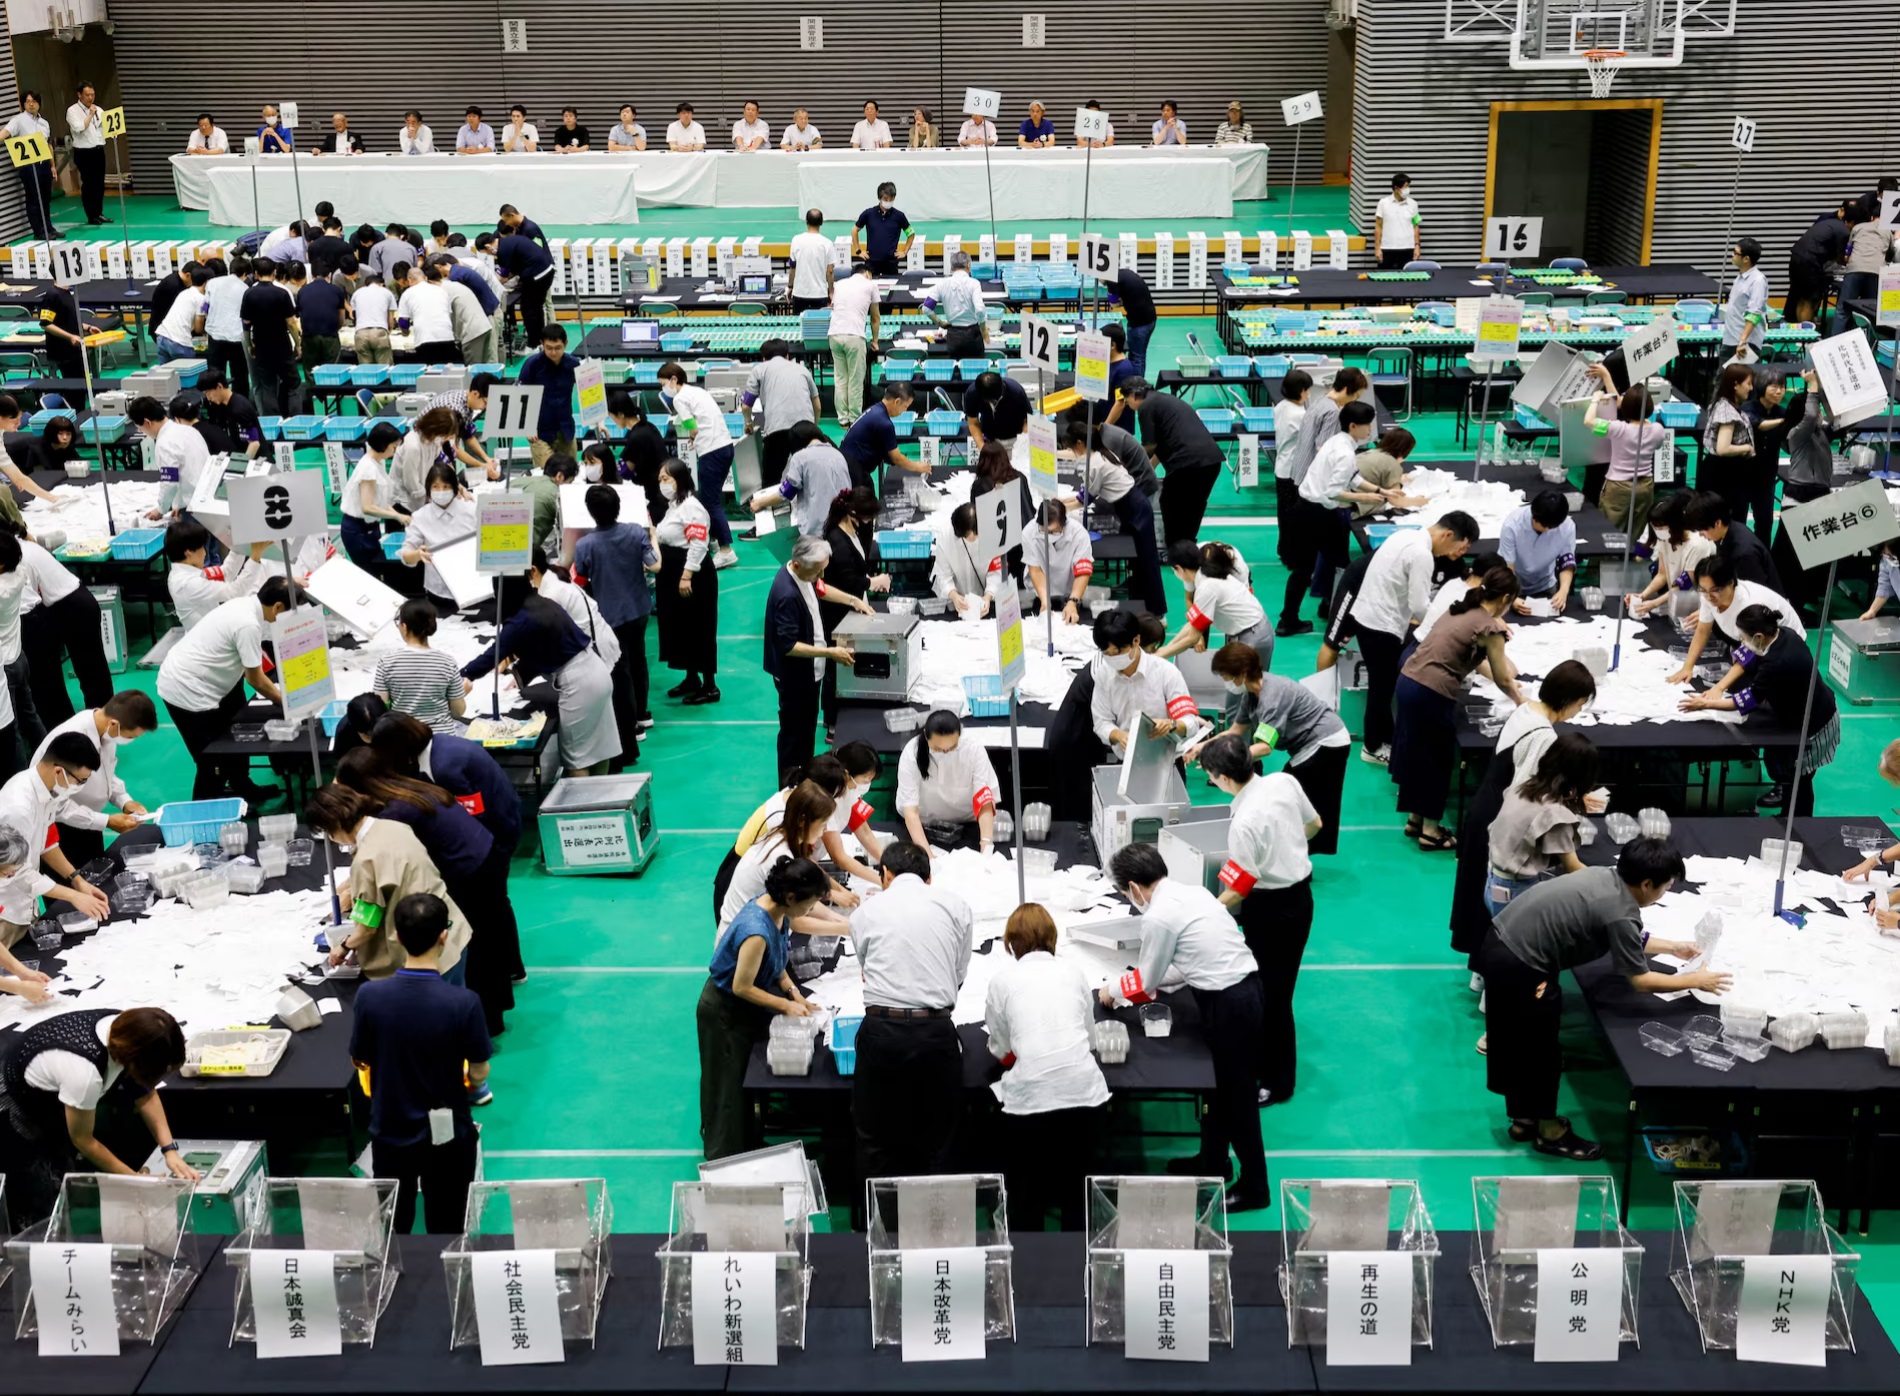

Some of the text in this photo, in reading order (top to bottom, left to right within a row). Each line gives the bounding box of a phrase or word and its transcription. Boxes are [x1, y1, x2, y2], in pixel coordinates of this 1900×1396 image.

[508, 20, 520, 50] 開票立会人
[106, 112, 121, 133] 23
[973, 96, 992, 109] 30
[1083, 117, 1101, 130] 28
[1291, 101, 1312, 116] 29
[14, 138, 41, 161] 21
[1736, 122, 1753, 145] 27
[1087, 241, 1110, 272] 15
[1499, 223, 1528, 251] 16
[60, 247, 83, 278] 13
[1028, 321, 1050, 363] 12
[498, 395, 529, 429] 11
[327, 445, 342, 491] れいわ新選組
[1242, 447, 1251, 475] 参政党
[264, 485, 293, 530] 8
[996, 500, 1007, 547] 9
[62, 1248, 87, 1353] チームみらい
[284, 1258, 306, 1339] 日本誠真会
[504, 1260, 530, 1350] 社会民主党
[724, 1256, 744, 1362] れいわ新選組
[933, 1260, 951, 1345] 日本改革党
[1157, 1262, 1176, 1351] 自由民主党
[1360, 1264, 1379, 1335] 再生の道
[1568, 1262, 1588, 1334] 公明党
[1770, 1269, 1796, 1334] NHK党
